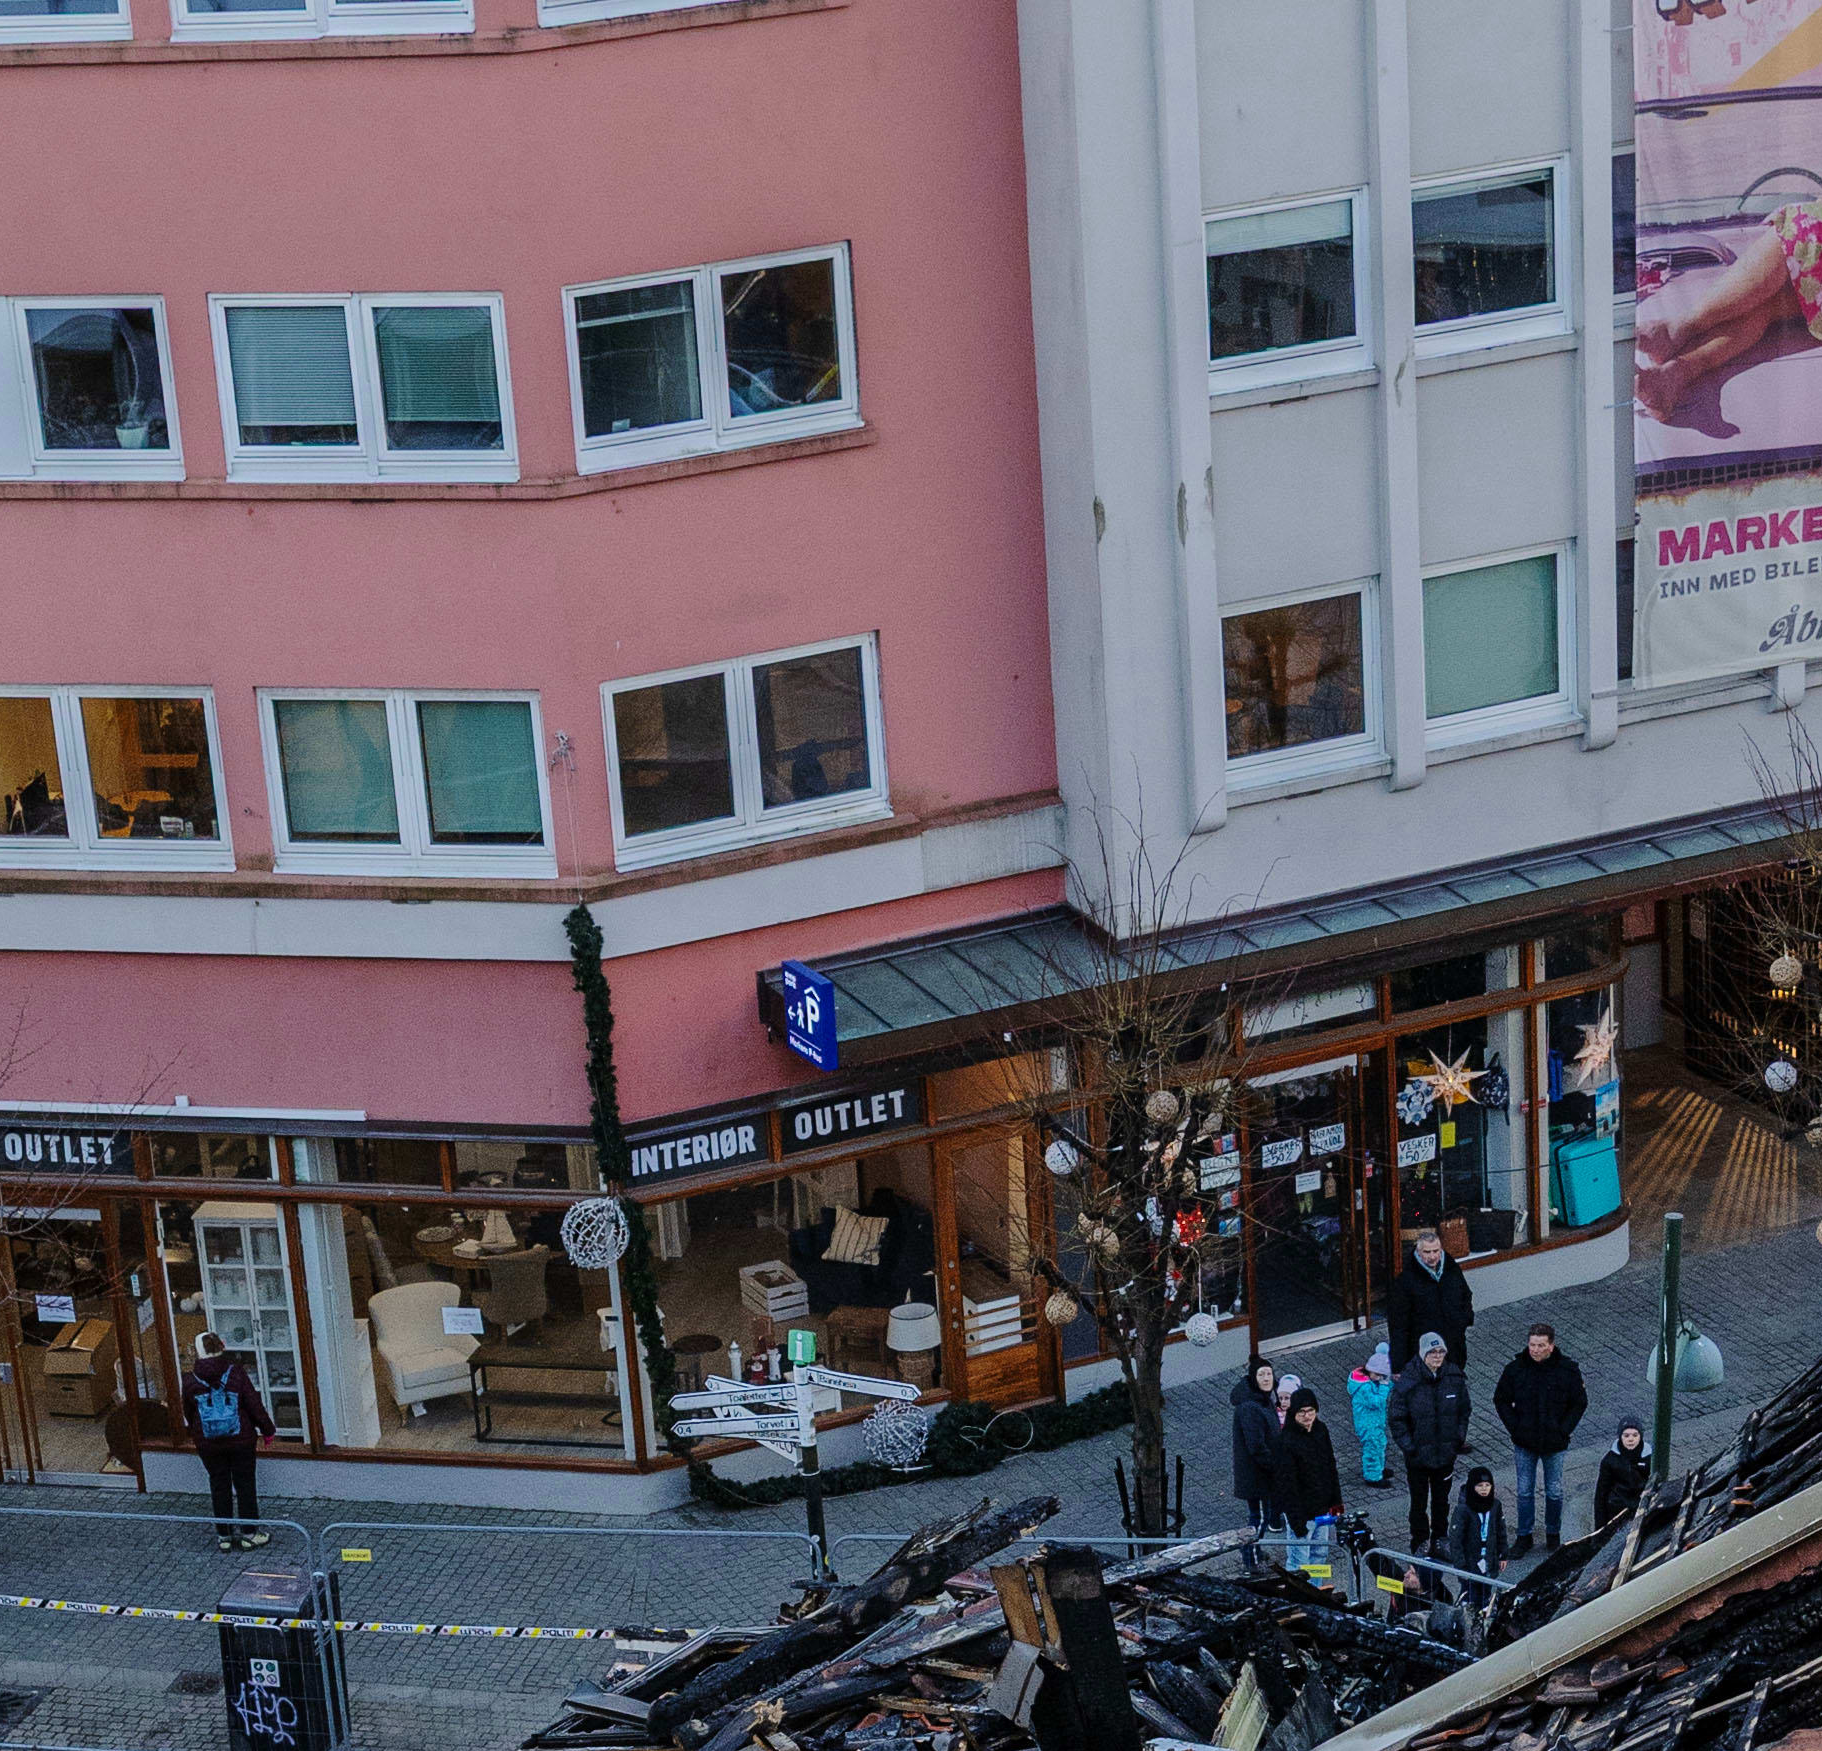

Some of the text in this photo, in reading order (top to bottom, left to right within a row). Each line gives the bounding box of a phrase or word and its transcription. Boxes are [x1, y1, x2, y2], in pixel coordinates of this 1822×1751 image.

[1659, 580, 1701, 600] INN
[1709, 571, 1758, 594] MED
[805, 995, 820, 1035] P
[3, 1130, 116, 1166] OUTLET
[630, 1089, 906, 1177] INTERIØR OUTLET
[676, 1419, 785, 1435] 0.4 Torvet
[65, 1602, 98, 1613] POLITI
[222, 1615, 255, 1625] POLITI
[380, 1625, 414, 1633] POLITI
[541, 1629, 575, 1638] POLITI
